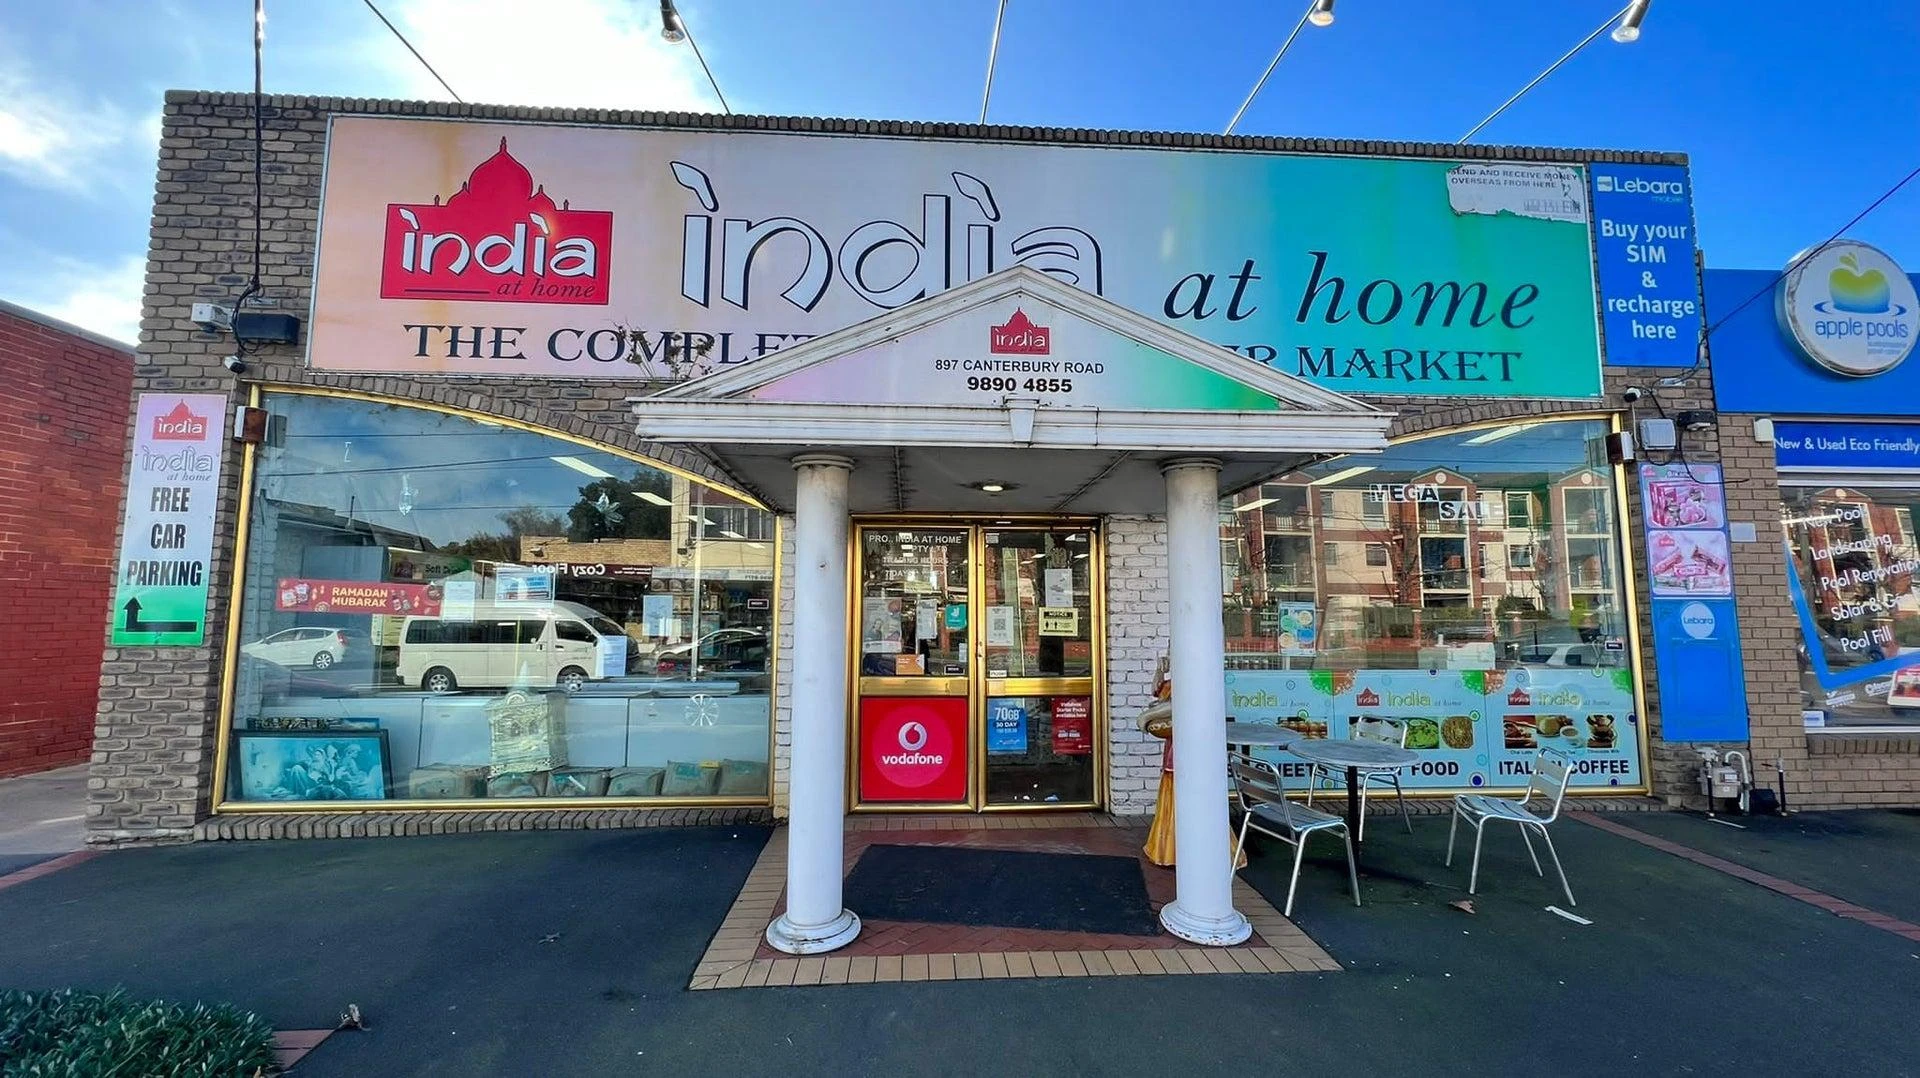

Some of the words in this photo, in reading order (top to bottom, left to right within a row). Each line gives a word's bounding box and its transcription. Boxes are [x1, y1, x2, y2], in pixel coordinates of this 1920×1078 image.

[1451, 177, 1501, 185] OVERSEAS
[1503, 171, 1541, 179] RECEIVE
[1545, 173, 1577, 181] MONEY
[1614, 176, 1683, 195] Lebara
[669, 161, 1103, 312] india
[1601, 219, 1639, 242] Buy
[1644, 224, 1687, 242] your
[399, 208, 597, 278] india
[1626, 245, 1666, 263] SIM
[496, 281, 522, 297] at
[530, 278, 596, 298] home
[1641, 271, 1658, 288] &
[1163, 259, 1262, 322] at
[1296, 251, 1540, 330] home
[1608, 295, 1695, 319] recharge
[995, 328, 1046, 348] india
[1631, 320, 1677, 339] here
[1815, 318, 1863, 339] apple
[1866, 320, 1909, 341] pools
[403, 324, 528, 360] THE
[546, 328, 818, 366] COMPLE
[935, 359, 959, 371] 897
[963, 360, 1060, 373] CANTERBURY
[1064, 362, 1104, 374] ROAD
[1296, 346, 1523, 383] MARKET
[967, 376, 1017, 392] 9890
[1023, 378, 1073, 393] 4855
[157, 417, 203, 434] india
[1774, 437, 1801, 450] New
[1804, 437, 1815, 450] &
[1817, 437, 1847, 450] Used
[1850, 438, 1872, 451] Eco
[1874, 438, 1920, 455] Friendly
[141, 445, 213, 472] india
[183, 473, 212, 482] home
[150, 487, 191, 512] FREE
[1370, 484, 1438, 501] MEGA
[1835, 508, 1865, 523] Pool
[150, 523, 186, 549] CAR
[921, 536, 933, 544] AT
[935, 536, 962, 544] HOME
[1809, 534, 1893, 561] Landscaping
[126, 561, 203, 586] PARKING
[1821, 570, 1850, 591] Pool
[332, 587, 388, 598] RAMADAN
[331, 598, 387, 608] MUBARAK
[1831, 601, 1866, 621] Solar
[1869, 597, 1882, 612] &
[1683, 617, 1714, 625] Lebara
[1840, 631, 1870, 652] Pool
[1872, 625, 1892, 645] Fill
[882, 753, 943, 765] vodafone
[1411, 761, 1459, 776] FOOD
[1569, 760, 1630, 774] COFFEE
